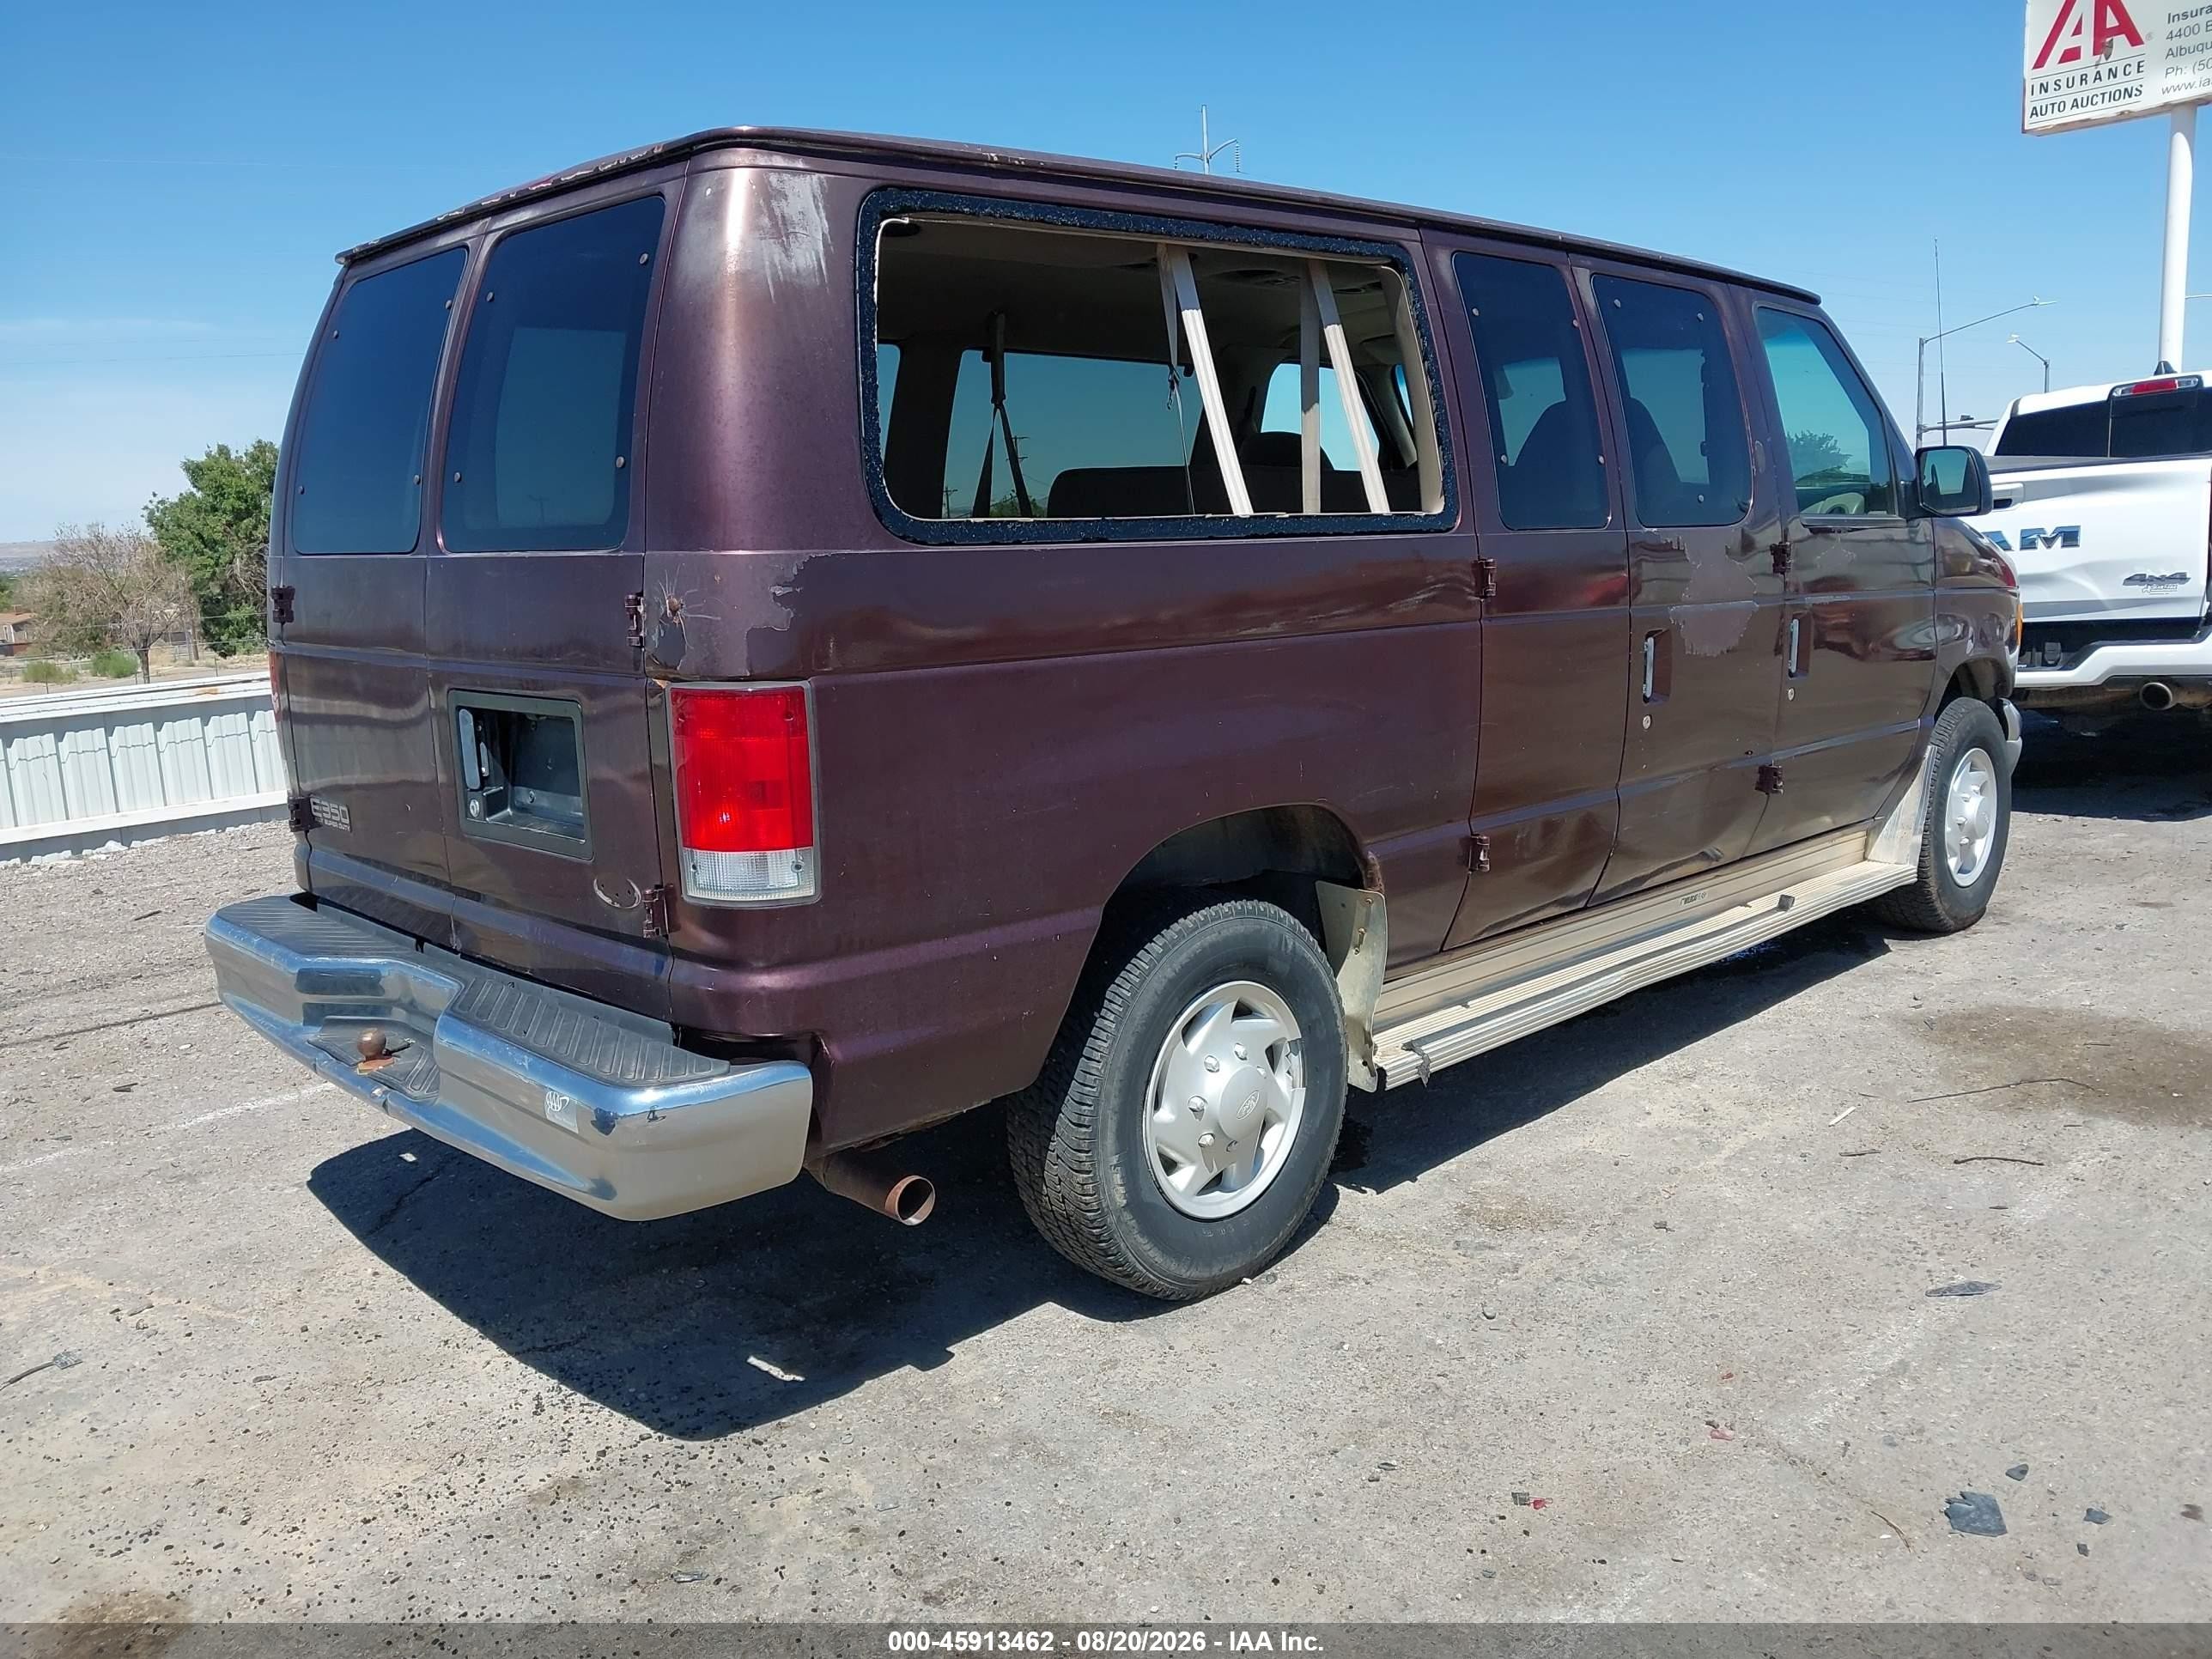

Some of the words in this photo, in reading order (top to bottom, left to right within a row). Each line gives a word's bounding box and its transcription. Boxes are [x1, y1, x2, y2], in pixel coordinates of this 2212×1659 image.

[2166, 22, 2200, 41] 4400
[2031, 60, 2145, 96] INSURANCE
[2165, 65, 2187, 78] Ph:
[2161, 76, 2212, 94] www.ia
[2030, 100, 2066, 118] AUTO
[2070, 84, 2143, 110] AUCTIONS
[1982, 526, 2081, 550] AM
